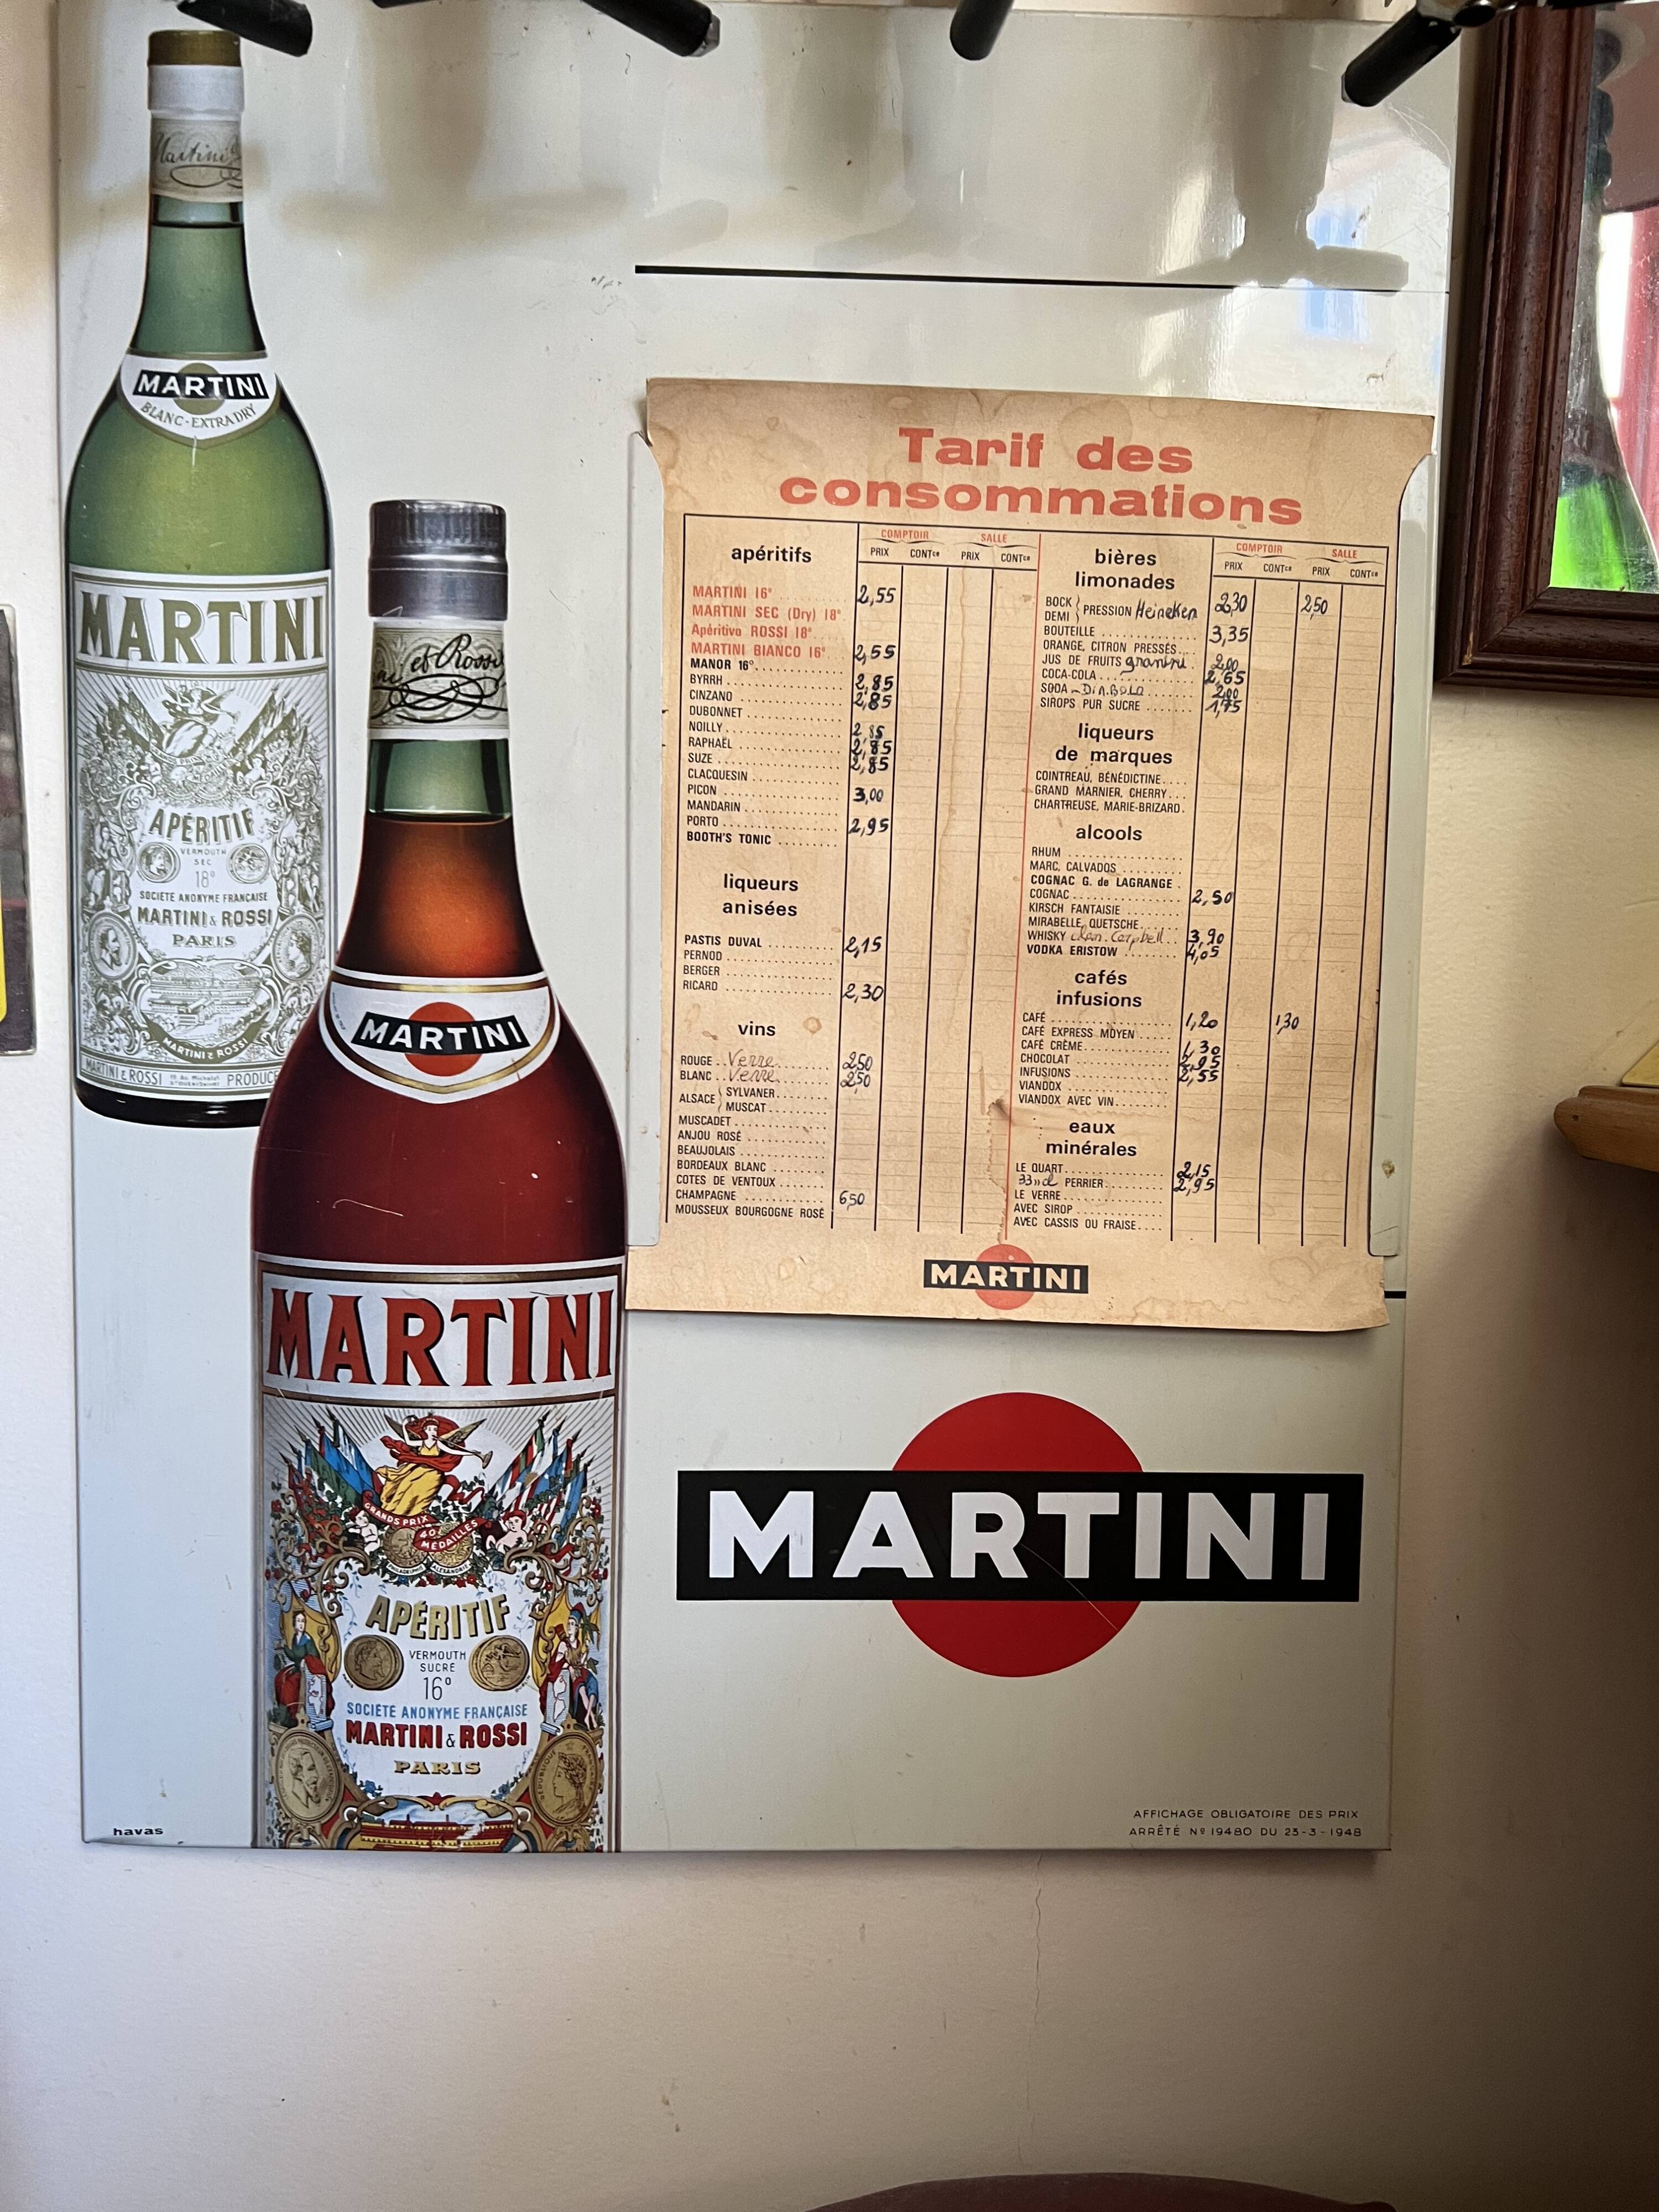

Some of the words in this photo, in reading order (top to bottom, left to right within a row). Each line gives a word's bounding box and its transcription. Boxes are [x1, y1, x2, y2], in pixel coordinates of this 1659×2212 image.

[138, 374, 266, 399] MARTINI
[899, 427, 1044, 468] Tarif
[1077, 436, 1192, 473] des
[780, 477, 1301, 525] consommations
[881, 530, 928, 540] COMPTOIR
[981, 534, 1006, 542] SALLE
[871, 547, 889, 556] PRIX
[1237, 543, 1282, 553] COMPTOIR
[732, 545, 811, 564] apéritifs
[962, 551, 979, 560] PRIX
[1095, 549, 1156, 566] bières
[1332, 549, 1357, 559] SALLE
[1225, 561, 1243, 570] PRIX
[1312, 567, 1330, 576] PRIX
[1076, 571, 1175, 589] limonades
[693, 586, 746, 598] MARTINI
[1046, 597, 1072, 607] BOCK
[693, 604, 745, 617] MARTINI
[755, 607, 778, 618] SEC
[788, 607, 815, 622] (Dry)
[1045, 611, 1069, 621] DEMI
[1084, 605, 1131, 616] PRESSION
[81, 591, 326, 664] MARTINI
[692, 624, 741, 638] Apéritivo
[751, 625, 787, 638] ROSSI
[1045, 625, 1094, 637] BOUTEILLE
[691, 642, 744, 655] MARTINI
[754, 645, 801, 658] BIANCO
[691, 658, 731, 669] MANOR
[1042, 654, 1061, 664] JUS
[1069, 655, 1080, 665] DE
[1088, 656, 1121, 666] FRUITS
[691, 674, 722, 685] BYRRH
[1042, 669, 1096, 680] COCA-COLA
[1041, 683, 1067, 693] SODA
[690, 690, 732, 701] CINZANO
[1041, 697, 1075, 708] SIROPS
[1083, 699, 1102, 709] PUR
[1109, 700, 1140, 711] SUCRE
[690, 706, 742, 718] DUBONNET
[689, 721, 722, 732] NOILLY
[1079, 723, 1153, 742] liqueurs
[689, 737, 732, 749] RAPHAËL
[688, 753, 712, 763] SUZE
[1056, 745, 1077, 761] de
[1091, 750, 1172, 766] marques
[688, 768, 747, 781] CLACQUESIN
[688, 784, 716, 795] PICON
[687, 800, 740, 812] MANDARIN
[149, 808, 255, 844] APÉRITIF
[687, 816, 718, 826] PORTO
[687, 831, 732, 843] BOOTH'S
[739, 834, 771, 844] TONIC
[1076, 825, 1142, 841] alcools
[1032, 847, 1060, 857] RHUM
[724, 873, 798, 893] liqueurs
[1031, 875, 1074, 885] COGNAC
[1083, 877, 1092, 885] G.
[1098, 877, 1109, 886] de
[1117, 878, 1172, 888] LAGRANGE
[1030, 889, 1069, 899] COGNAC
[723, 900, 797, 916] anisées
[1029, 902, 1063, 913] KIRSCH
[1071, 904, 1120, 915] FANTAISIE
[138, 906, 207, 927] MARTINI
[210, 916, 217, 926] &
[222, 909, 272, 927] ROSSI
[173, 935, 236, 947] PARIS
[685, 935, 721, 945] PASTIS
[729, 937, 761, 947] DUVAL
[1028, 930, 1066, 941] WHISKY
[684, 950, 722, 961] PERNOD
[1027, 945, 1062, 954] VODKA
[1070, 946, 1117, 956] ERISTOW
[684, 965, 719, 975] BERGER
[1075, 970, 1126, 985] cafés
[684, 980, 717, 990] RICARD
[1057, 990, 1141, 1007] infusions
[1023, 1011, 1045, 1022] CAFÉ
[738, 1021, 775, 1036] vins
[1022, 1025, 1044, 1036] CAFÉ
[1052, 1027, 1093, 1037] EXPRESS
[1100, 1028, 1134, 1039] MOYEN
[361, 1019, 526, 1050] MARTINI
[1021, 1039, 1044, 1050] CAFÉ
[1051, 1039, 1082, 1051] CRÈME
[681, 1056, 712, 1066] ROUGE
[1021, 1053, 1070, 1063] CHOCOLAT
[680, 1071, 711, 1081] BLANC
[1020, 1067, 1070, 1078] INFUSIONS
[1020, 1081, 1061, 1091] VIANDOX
[727, 1087, 774, 1098] SYLVANER
[680, 1094, 715, 1104] ALSACE
[1019, 1094, 1061, 1104] VIANDOX
[1067, 1096, 1091, 1105] AVEC
[1098, 1097, 1113, 1106] VIN
[726, 1102, 766, 1112] MUSCAT
[679, 1115, 731, 1126] MUSCADET
[1070, 1123, 1115, 1134] eaux
[678, 1130, 709, 1140] ANJOU
[717, 1130, 741, 1141] ROSÉ
[678, 1145, 735, 1156] BEAUJOLAIS
[1046, 1140, 1136, 1156] minérales
[677, 1160, 728, 1171] BORDEAUX
[735, 1162, 765, 1172] BLANC
[1016, 1163, 1026, 1172] LE
[1032, 1163, 1063, 1173] QUART
[677, 1175, 706, 1185] COTES
[714, 1176, 724, 1185] DE
[732, 1176, 775, 1187] VENTOUX
[1065, 1178, 1103, 1188] PERRIER
[676, 1190, 735, 1201] CHAMPAGNE
[1015, 1190, 1025, 1199] LE
[1032, 1191, 1060, 1200] VERRE
[676, 1204, 728, 1215] MOUSSEUX
[735, 1206, 793, 1217] BOURGOGNE
[800, 1208, 824, 1218] ROSÉ
[1014, 1203, 1037, 1213] AVEC
[1045, 1204, 1072, 1214] SIROP
[1014, 1217, 1037, 1226] AVEC
[1045, 1218, 1078, 1228] CASSIS
[1086, 1219, 1097, 1228] OU
[1104, 1219, 1136, 1230] FRAISE
[930, 1263, 1083, 1292] MARTINI
[266, 1287, 614, 1387] MARTINI
[709, 1490, 1329, 1581] MARTINI
[365, 1594, 510, 1641] APÉRITIF
[410, 1651, 465, 1660] VERMOUTH
[346, 1720, 442, 1749] MARTINI
[447, 1734, 455, 1748] &
[460, 1722, 527, 1749] ROSSI
[394, 1760, 481, 1775] PARIS
[1134, 1809, 1203, 1818] AFFICHAGE
[1211, 1810, 1290, 1818] OBLIGATOIRE
[1300, 1810, 1322, 1818] DES
[1129, 1824, 1180, 1835] ARRÊTÉ
[1212, 1827, 1251, 1835] 19480
